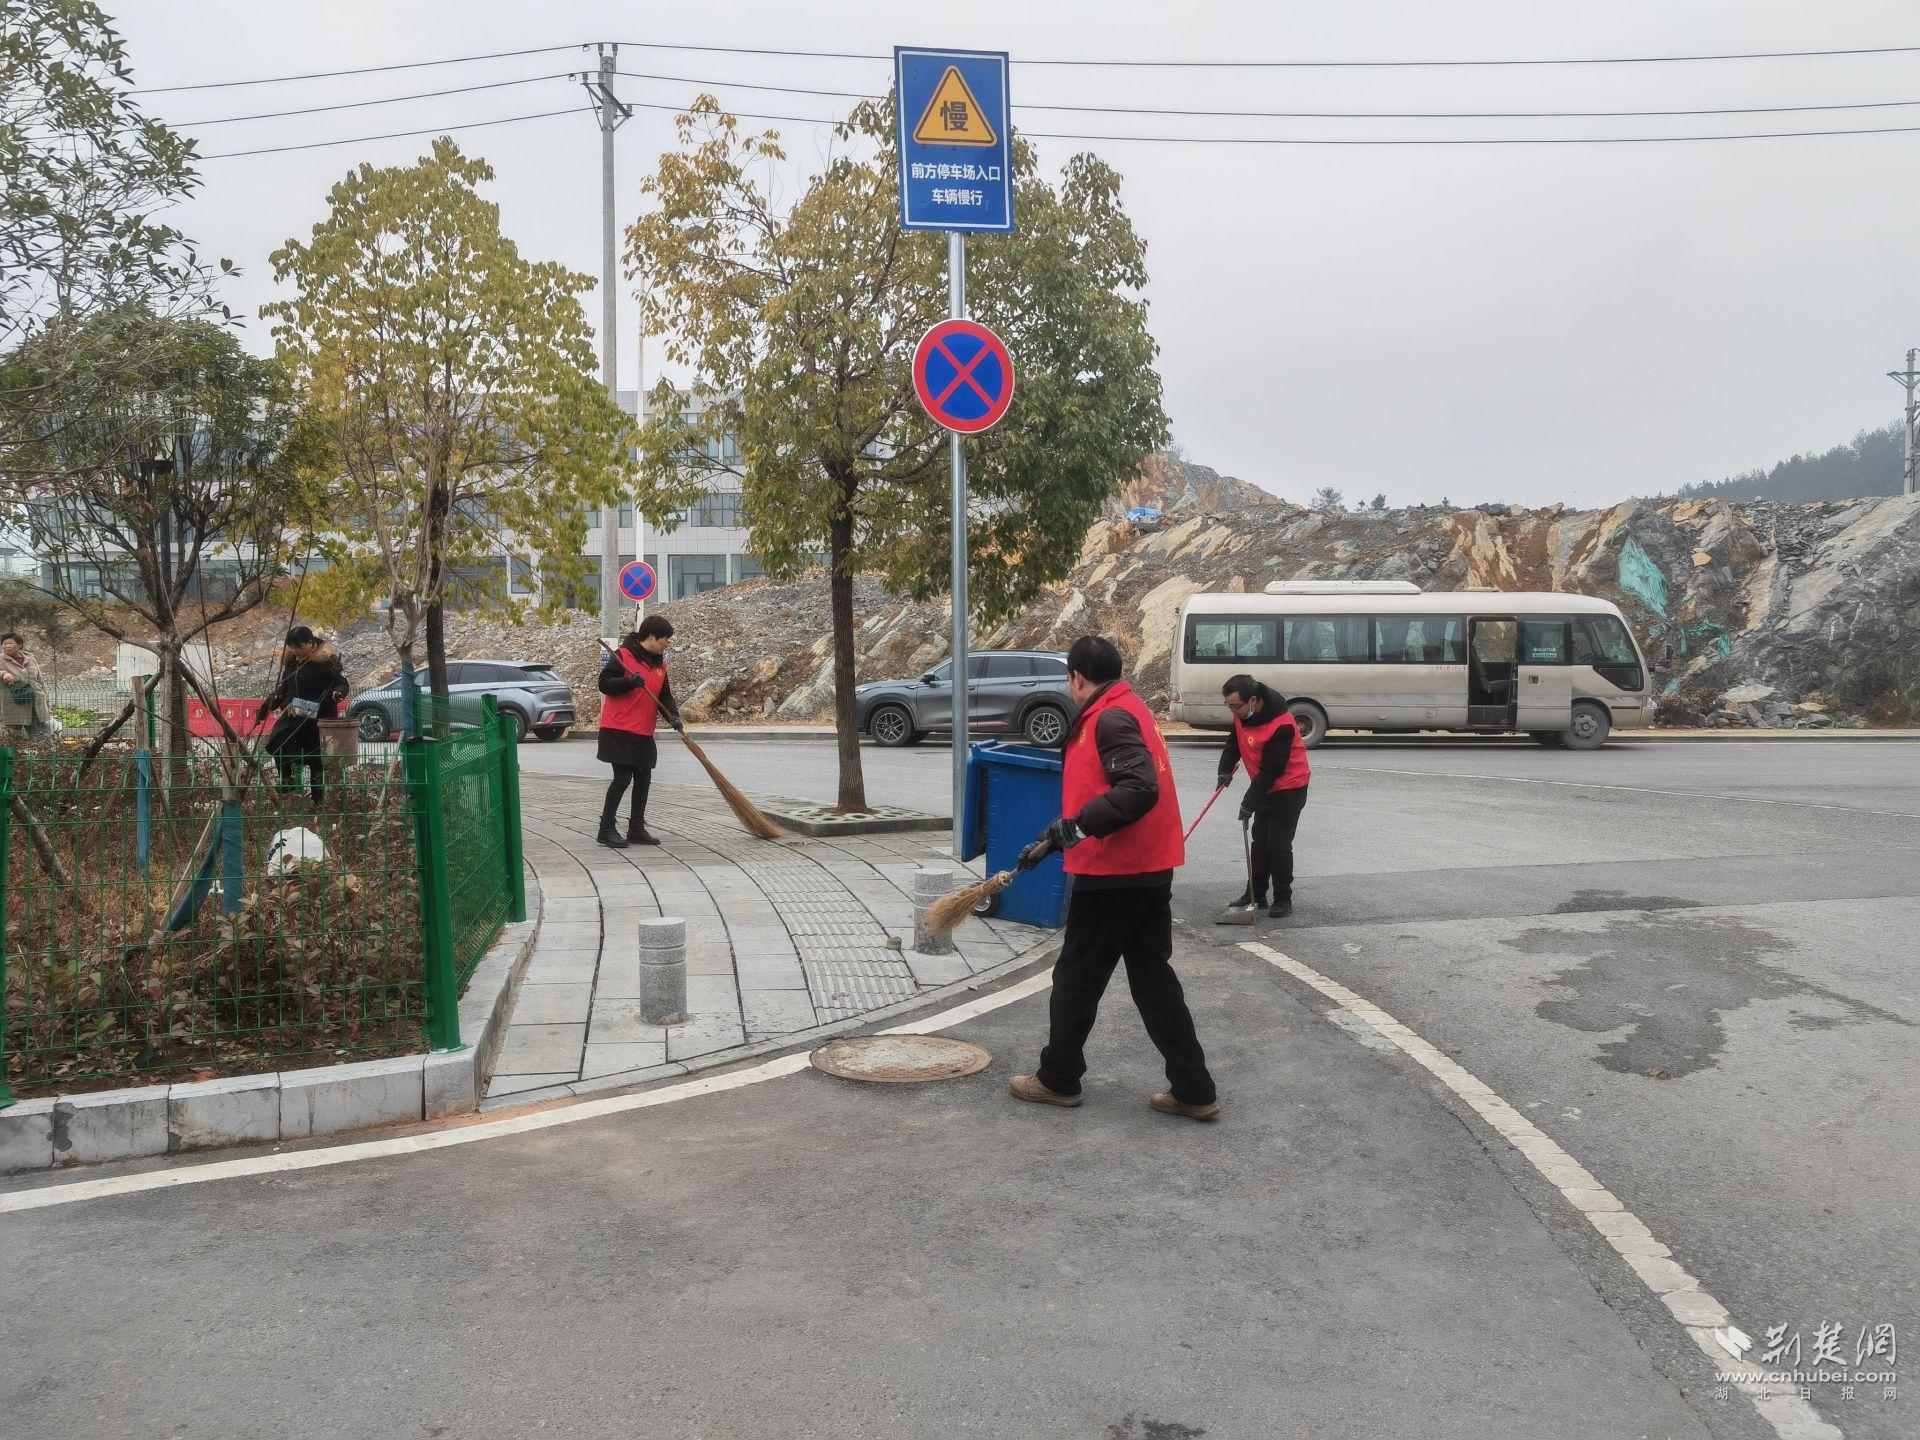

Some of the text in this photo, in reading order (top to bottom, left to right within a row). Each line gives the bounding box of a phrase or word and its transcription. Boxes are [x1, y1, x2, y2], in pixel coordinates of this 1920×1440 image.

[940, 100, 969, 132] 慢
[911, 162, 1000, 181] 前方停车场入口
[931, 188, 983, 206] 车辆慢行
